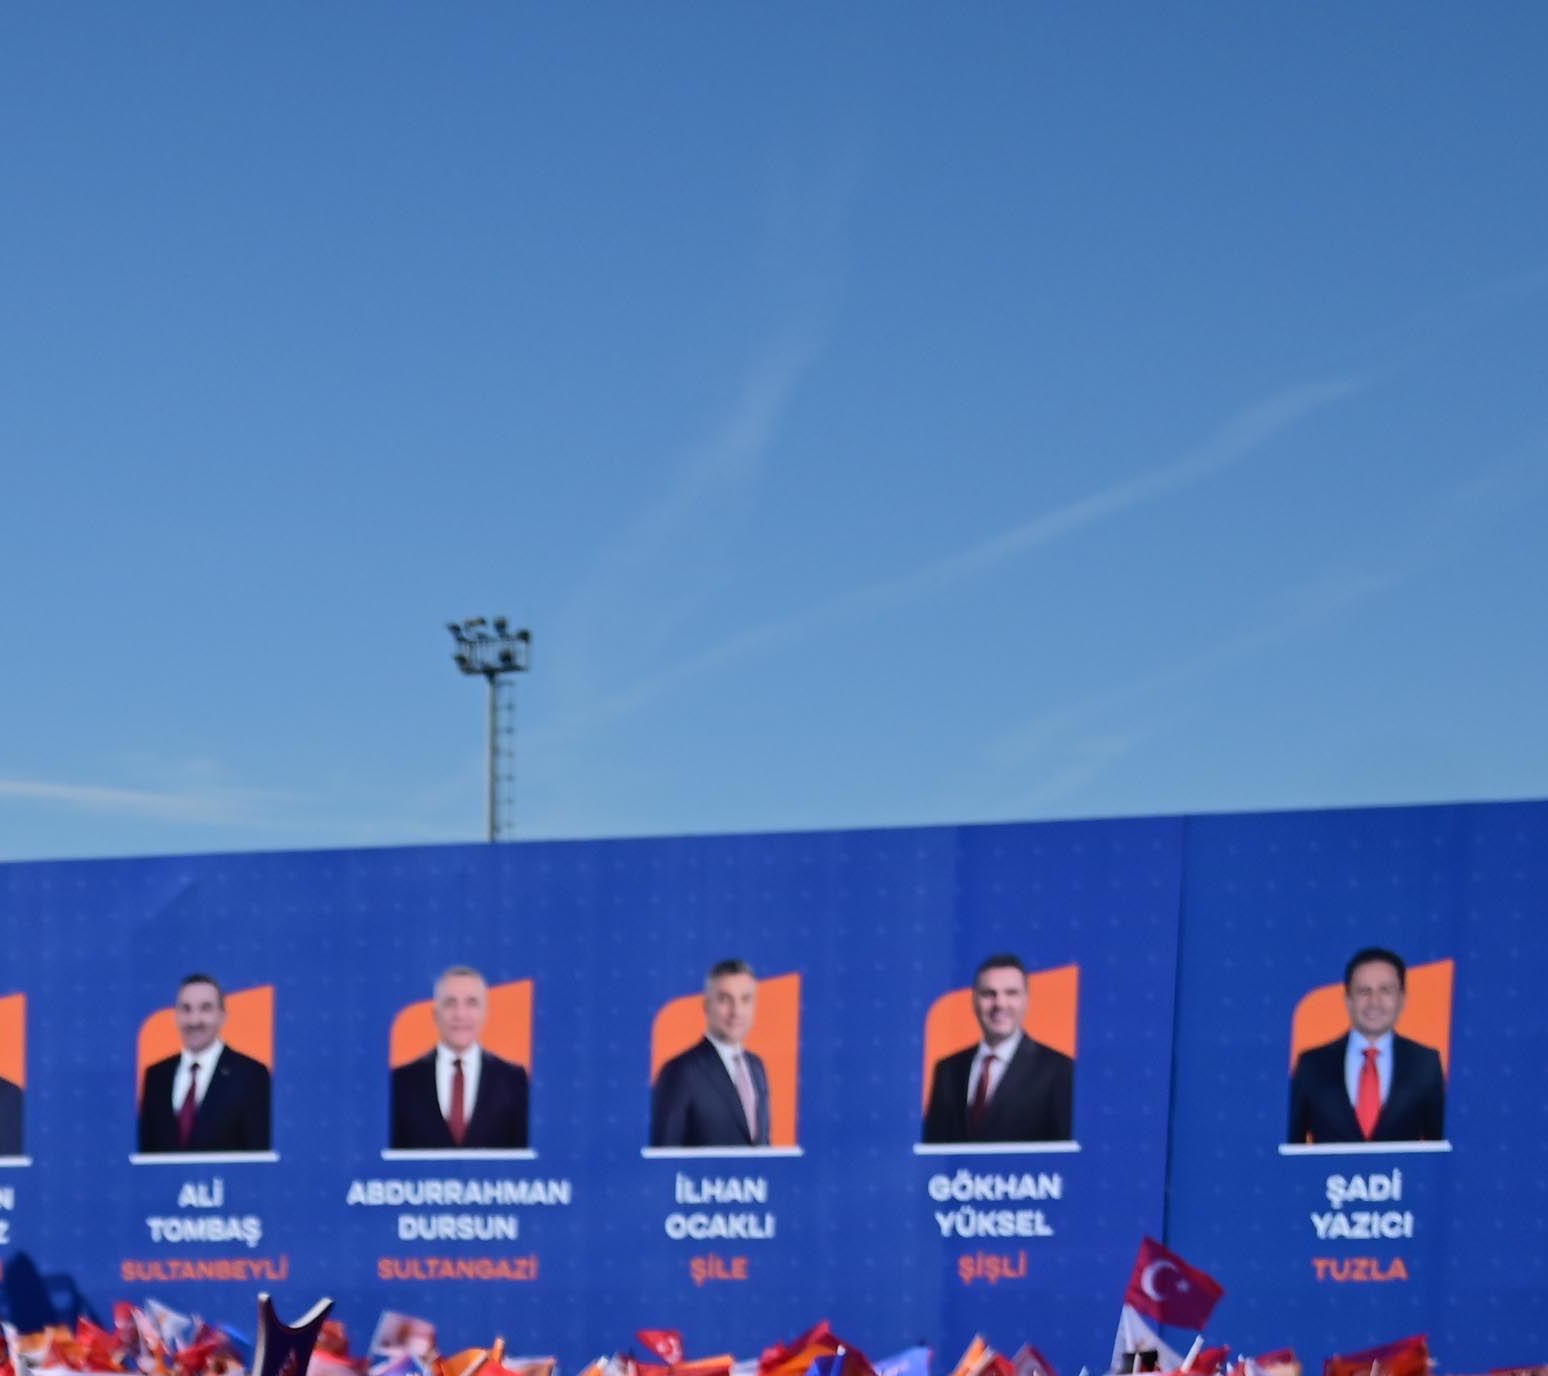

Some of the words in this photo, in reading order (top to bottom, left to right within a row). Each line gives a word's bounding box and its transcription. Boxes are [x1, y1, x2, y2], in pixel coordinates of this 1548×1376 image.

[346, 1180, 571, 1205] ABDURRAHMAN
[928, 1169, 1061, 1202] GÖKHAN
[398, 1214, 519, 1241] DURSUN
[935, 1206, 1054, 1238] YÜKSEL
[1311, 1257, 1408, 1281] TUZLA
